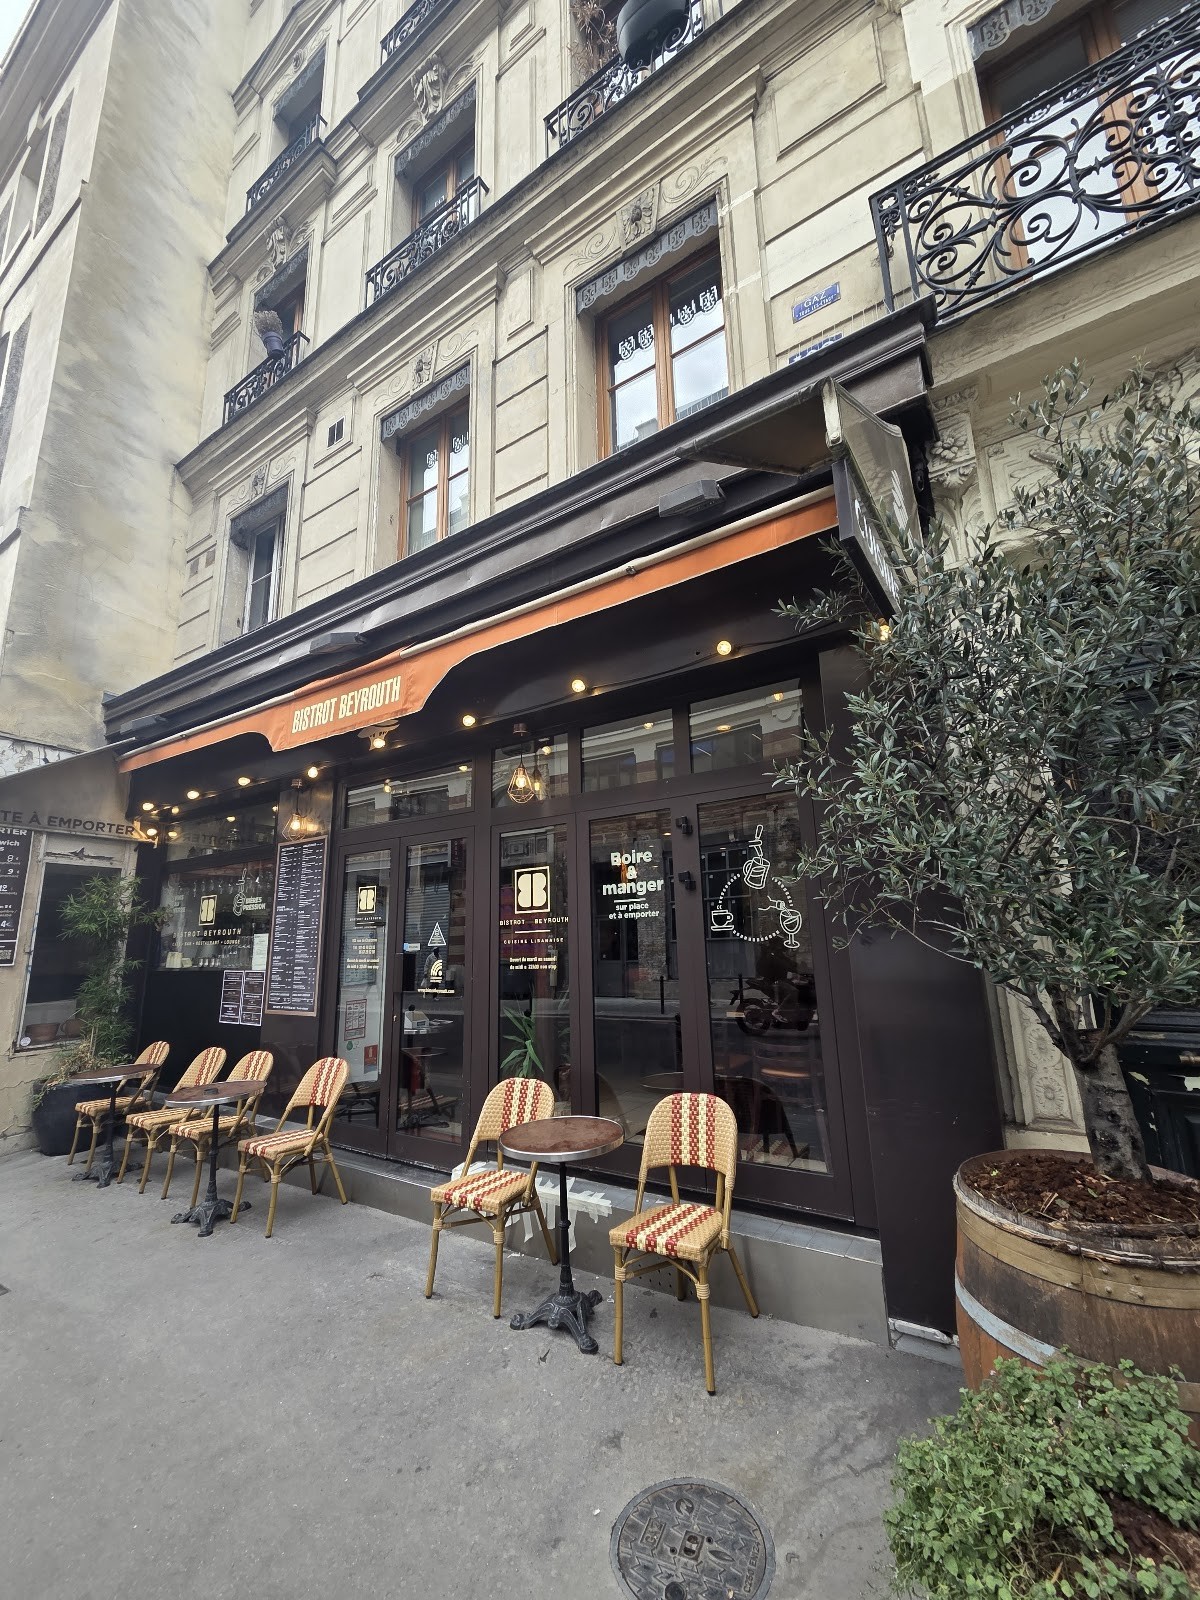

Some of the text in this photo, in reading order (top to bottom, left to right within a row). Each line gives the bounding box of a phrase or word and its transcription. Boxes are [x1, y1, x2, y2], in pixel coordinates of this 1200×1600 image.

[804, 291, 827, 308] GAZ
[292, 676, 401, 733] BISTROT BEYROUTH
[29, 811, 41, 825] À
[48, 816, 135, 835] EMPORTER
[610, 850, 653, 866] Boire
[626, 865, 637, 879] &
[602, 880, 664, 895] manger
[242, 903, 266, 911] PRESSION
[629, 902, 649, 911] place
[617, 911, 622, 919] à
[624, 910, 660, 919] emporter
[173, 928, 242, 938] BISTROT BEYROUTH
